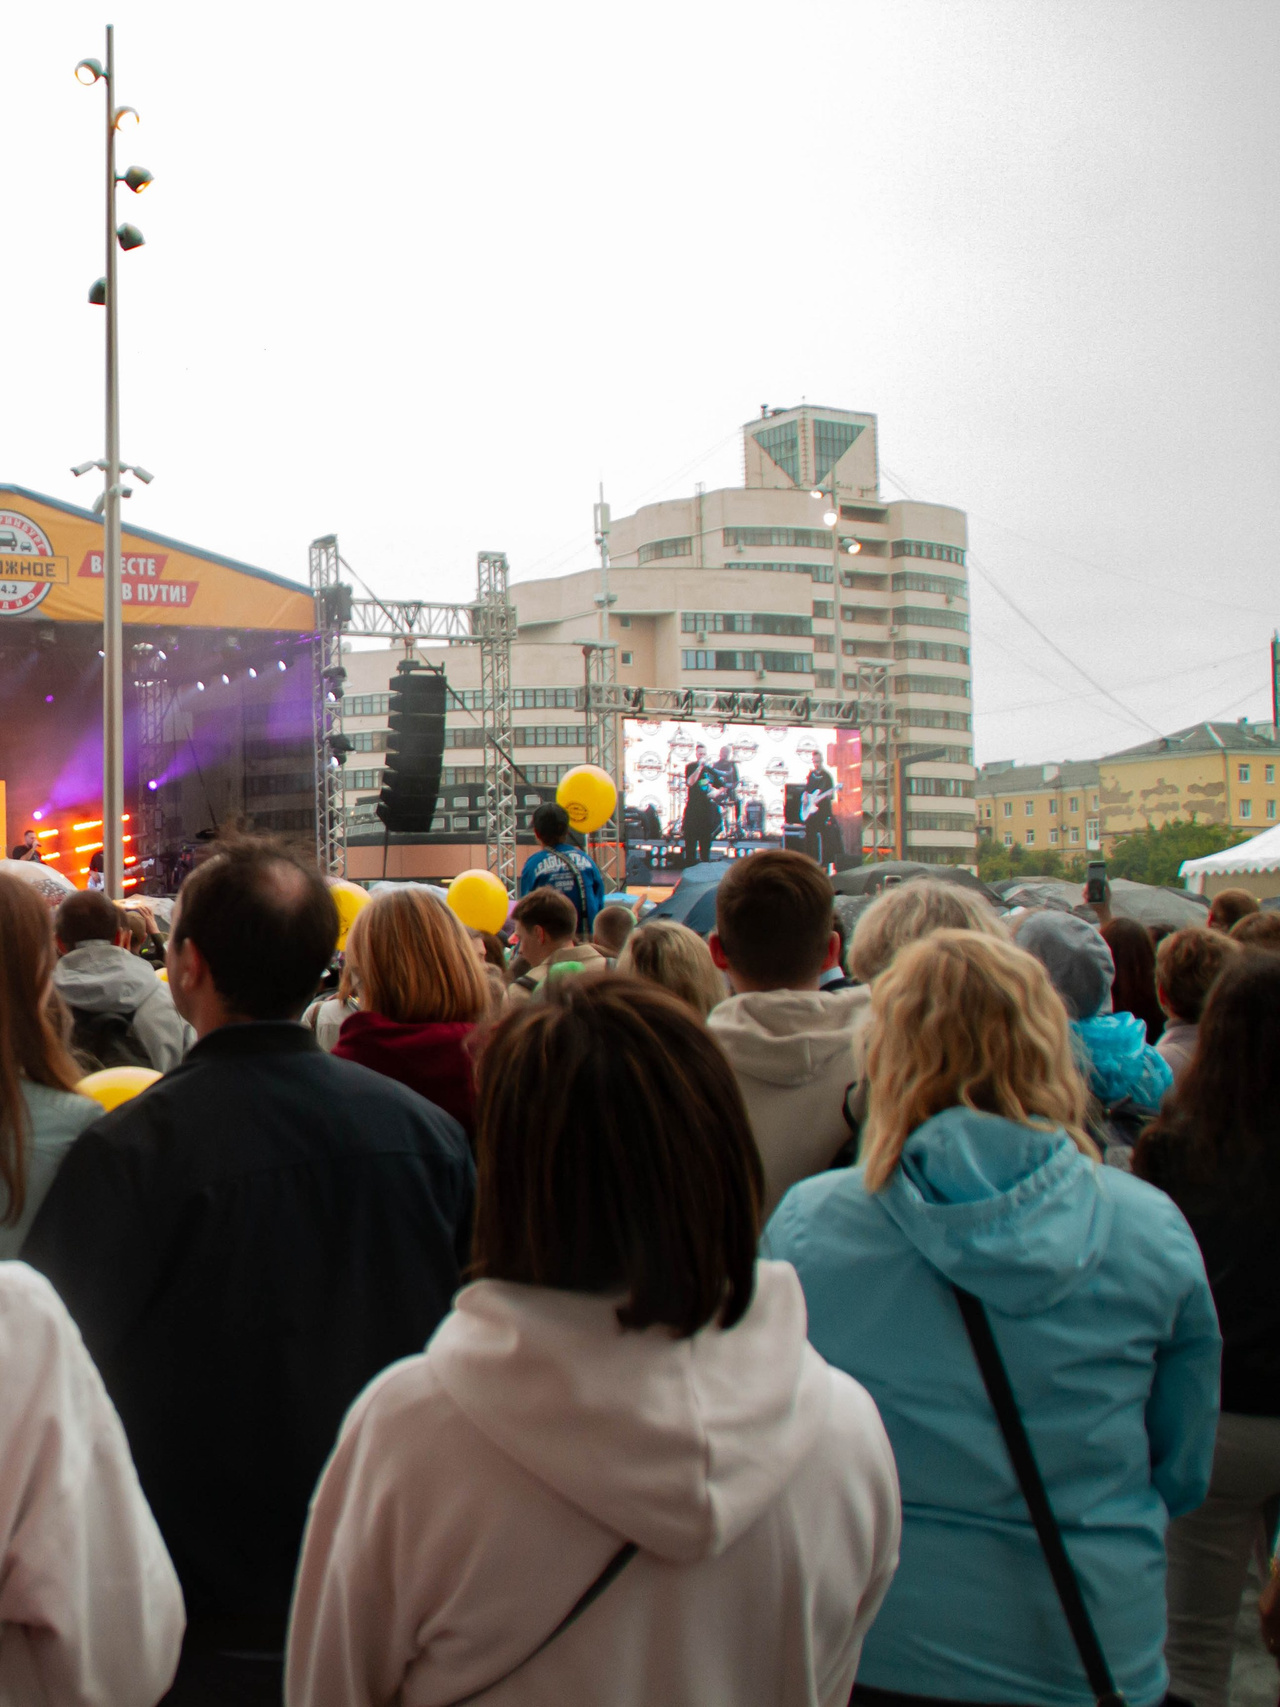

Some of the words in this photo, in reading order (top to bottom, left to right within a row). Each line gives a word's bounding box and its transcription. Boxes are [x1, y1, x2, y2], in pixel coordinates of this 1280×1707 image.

[91, 555, 156, 577] ВЕСТЕ
[122, 582, 133, 601] В
[137, 583, 187, 603] ПУТИ!
